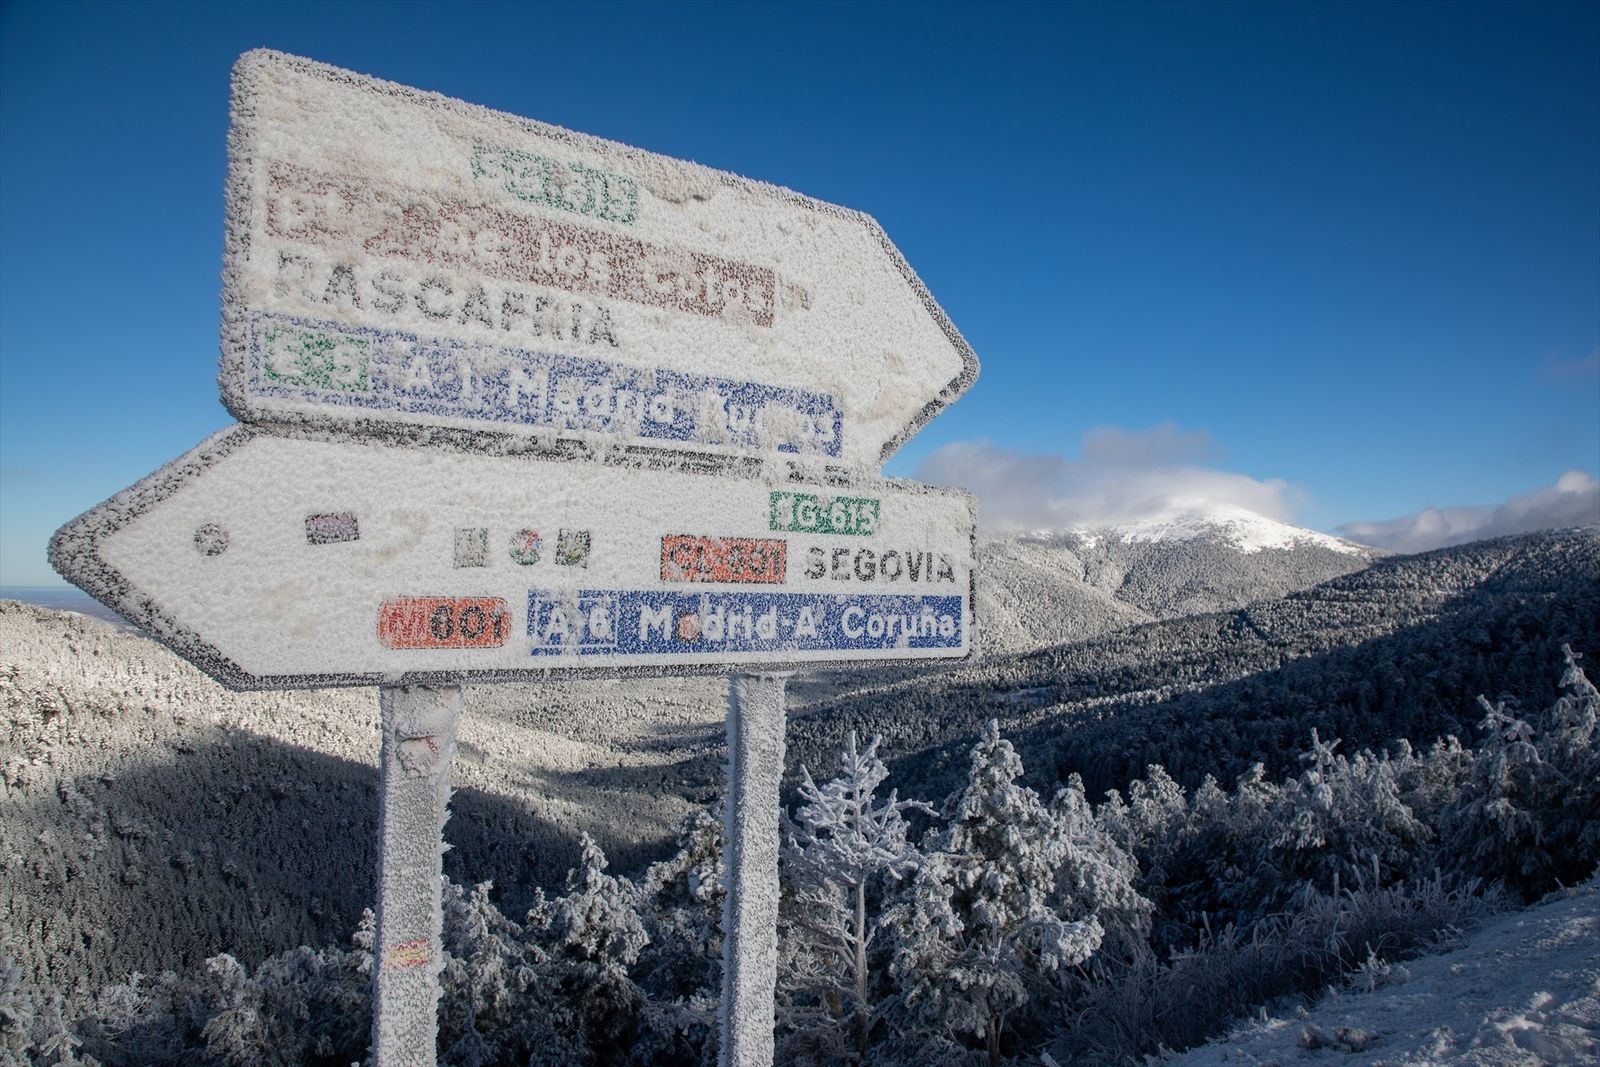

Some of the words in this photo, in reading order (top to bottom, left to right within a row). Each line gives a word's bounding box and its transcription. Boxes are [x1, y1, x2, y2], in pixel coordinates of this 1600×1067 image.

[539, 231, 602, 290] los
[644, 259, 767, 311] Cotos
[777, 498, 876, 532] SG-615
[804, 546, 955, 583] SEGOVIA
[841, 605, 956, 640] Coruña
